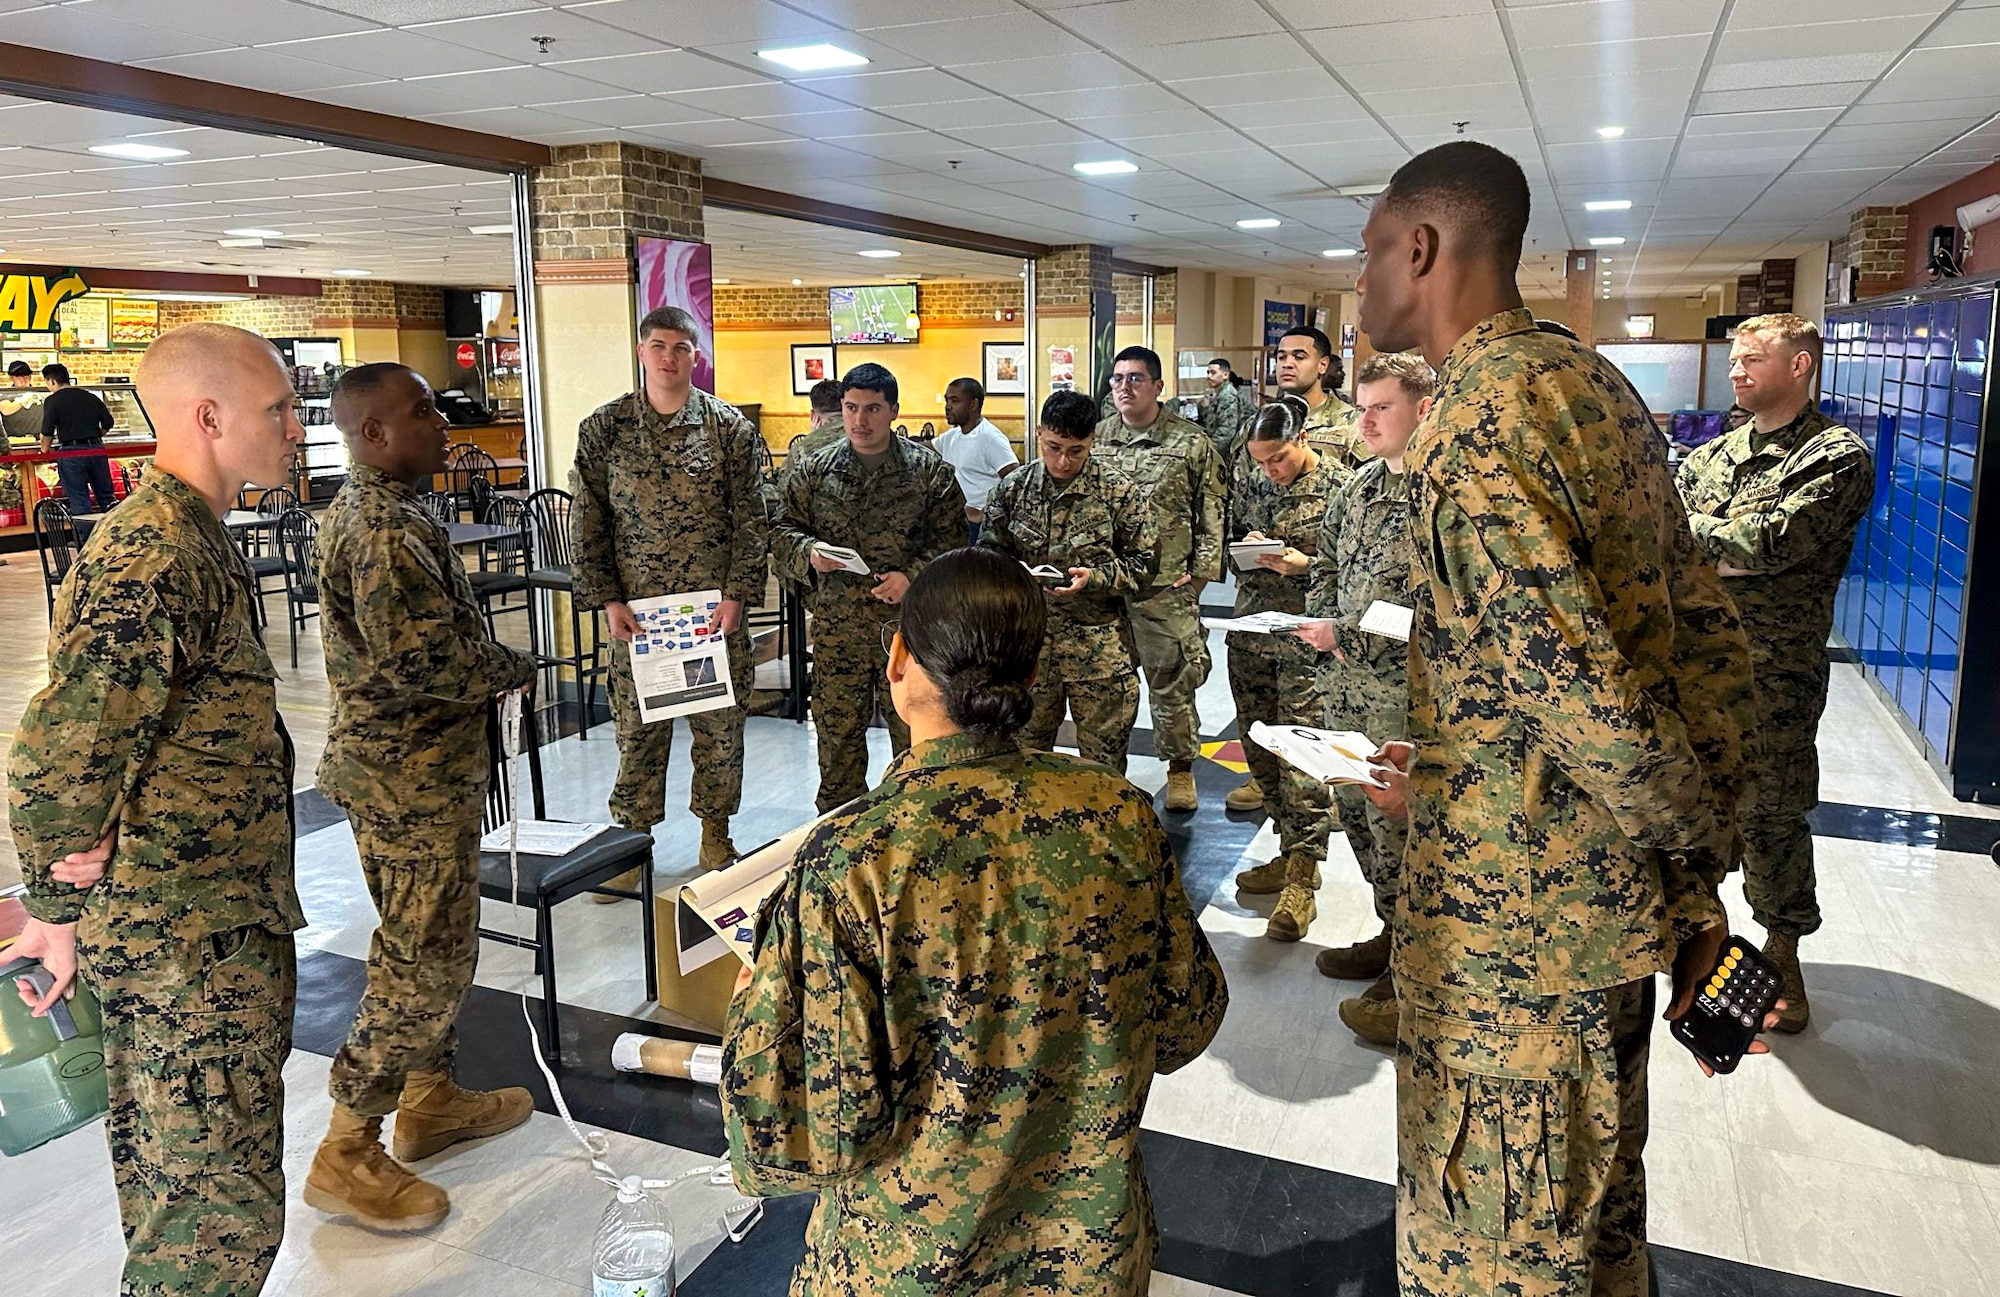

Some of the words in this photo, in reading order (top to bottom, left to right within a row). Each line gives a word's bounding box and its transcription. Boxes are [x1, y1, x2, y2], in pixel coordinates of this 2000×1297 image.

[0, 273, 88, 330] AY
[1747, 484, 1779, 498] MARINES
[1698, 993, 1721, 1016] 7,722
